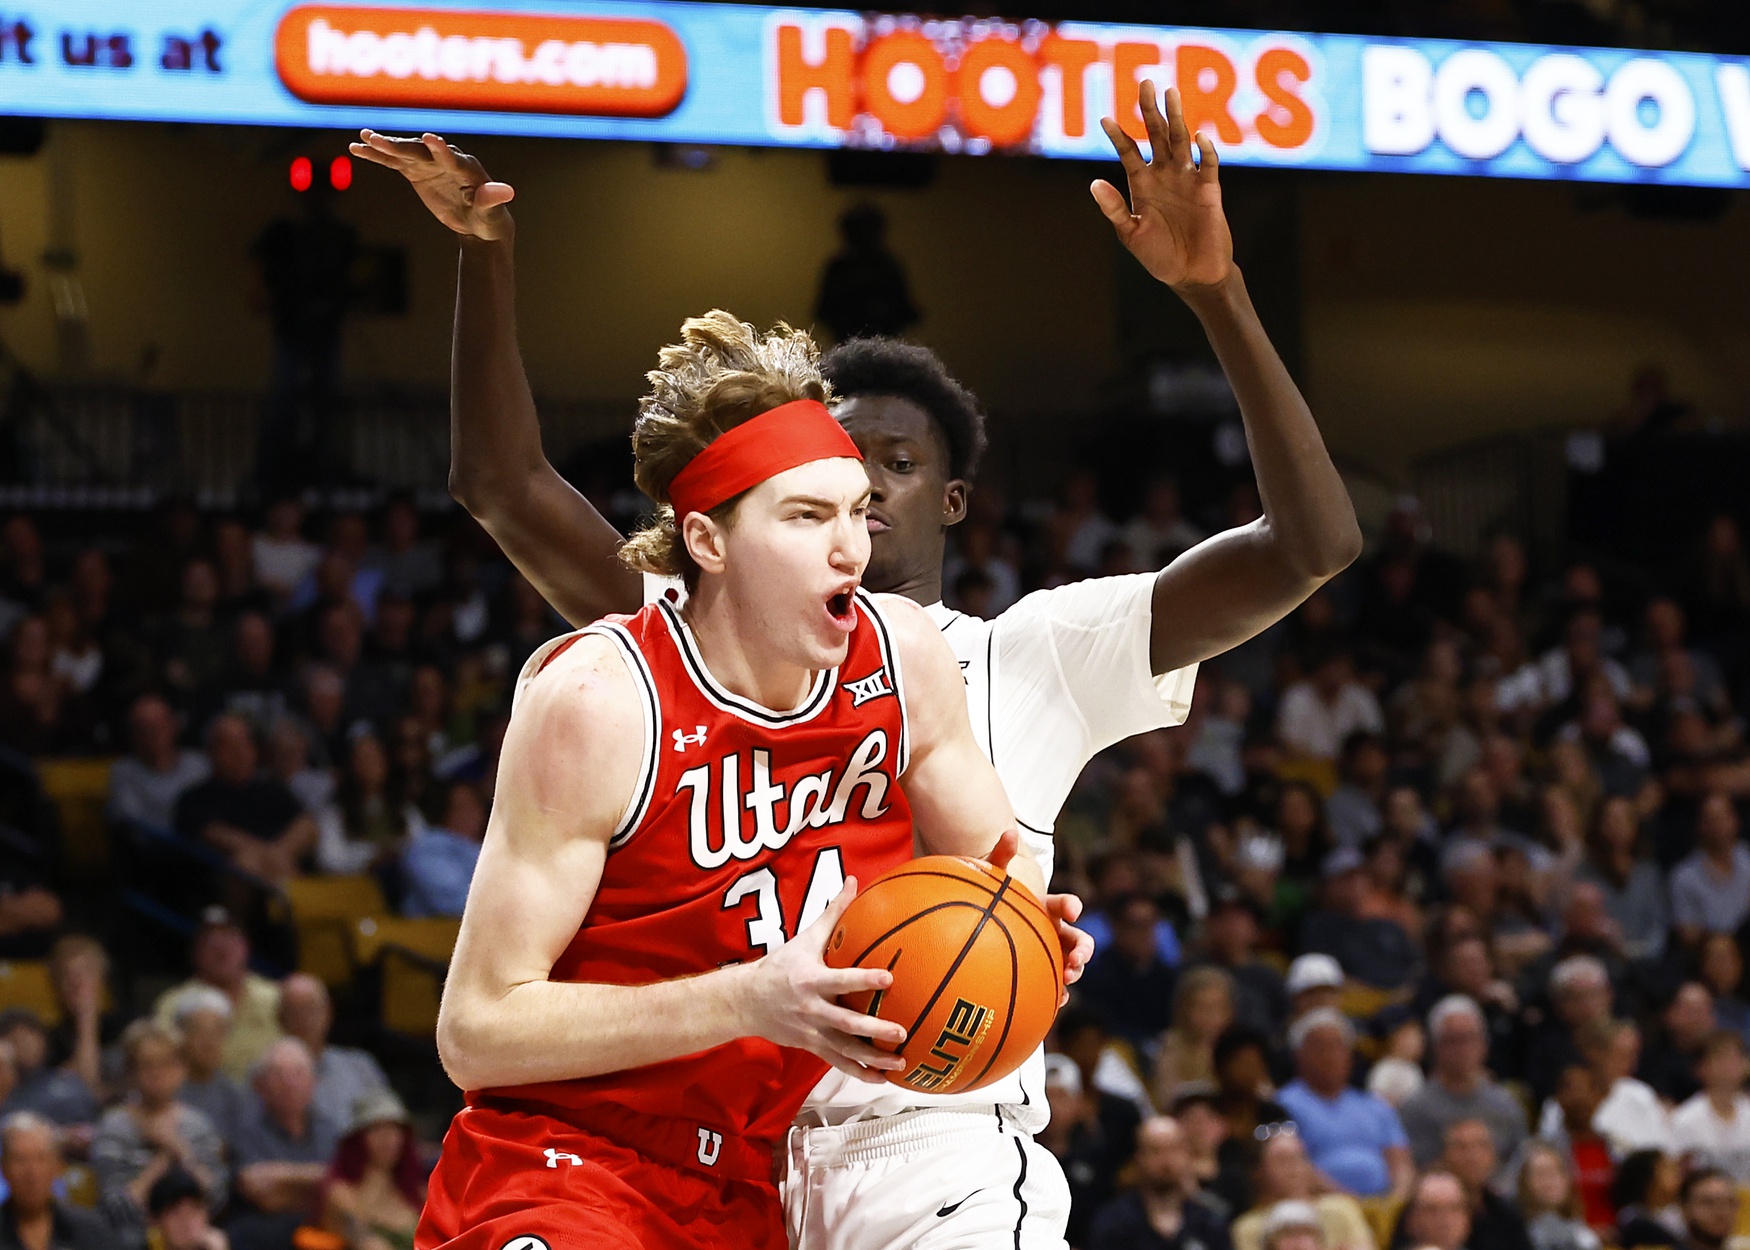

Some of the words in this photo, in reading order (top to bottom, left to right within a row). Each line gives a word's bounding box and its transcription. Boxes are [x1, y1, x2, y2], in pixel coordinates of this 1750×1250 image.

[62, 33, 132, 68] us
[162, 30, 222, 72] at
[307, 18, 657, 90] hooters.com
[776, 24, 1314, 149] HOOTERS
[1362, 44, 1696, 169] BOGO
[675, 728, 892, 870] Utah
[904, 997, 987, 1090] ELITE
[697, 1126, 723, 1167] U
